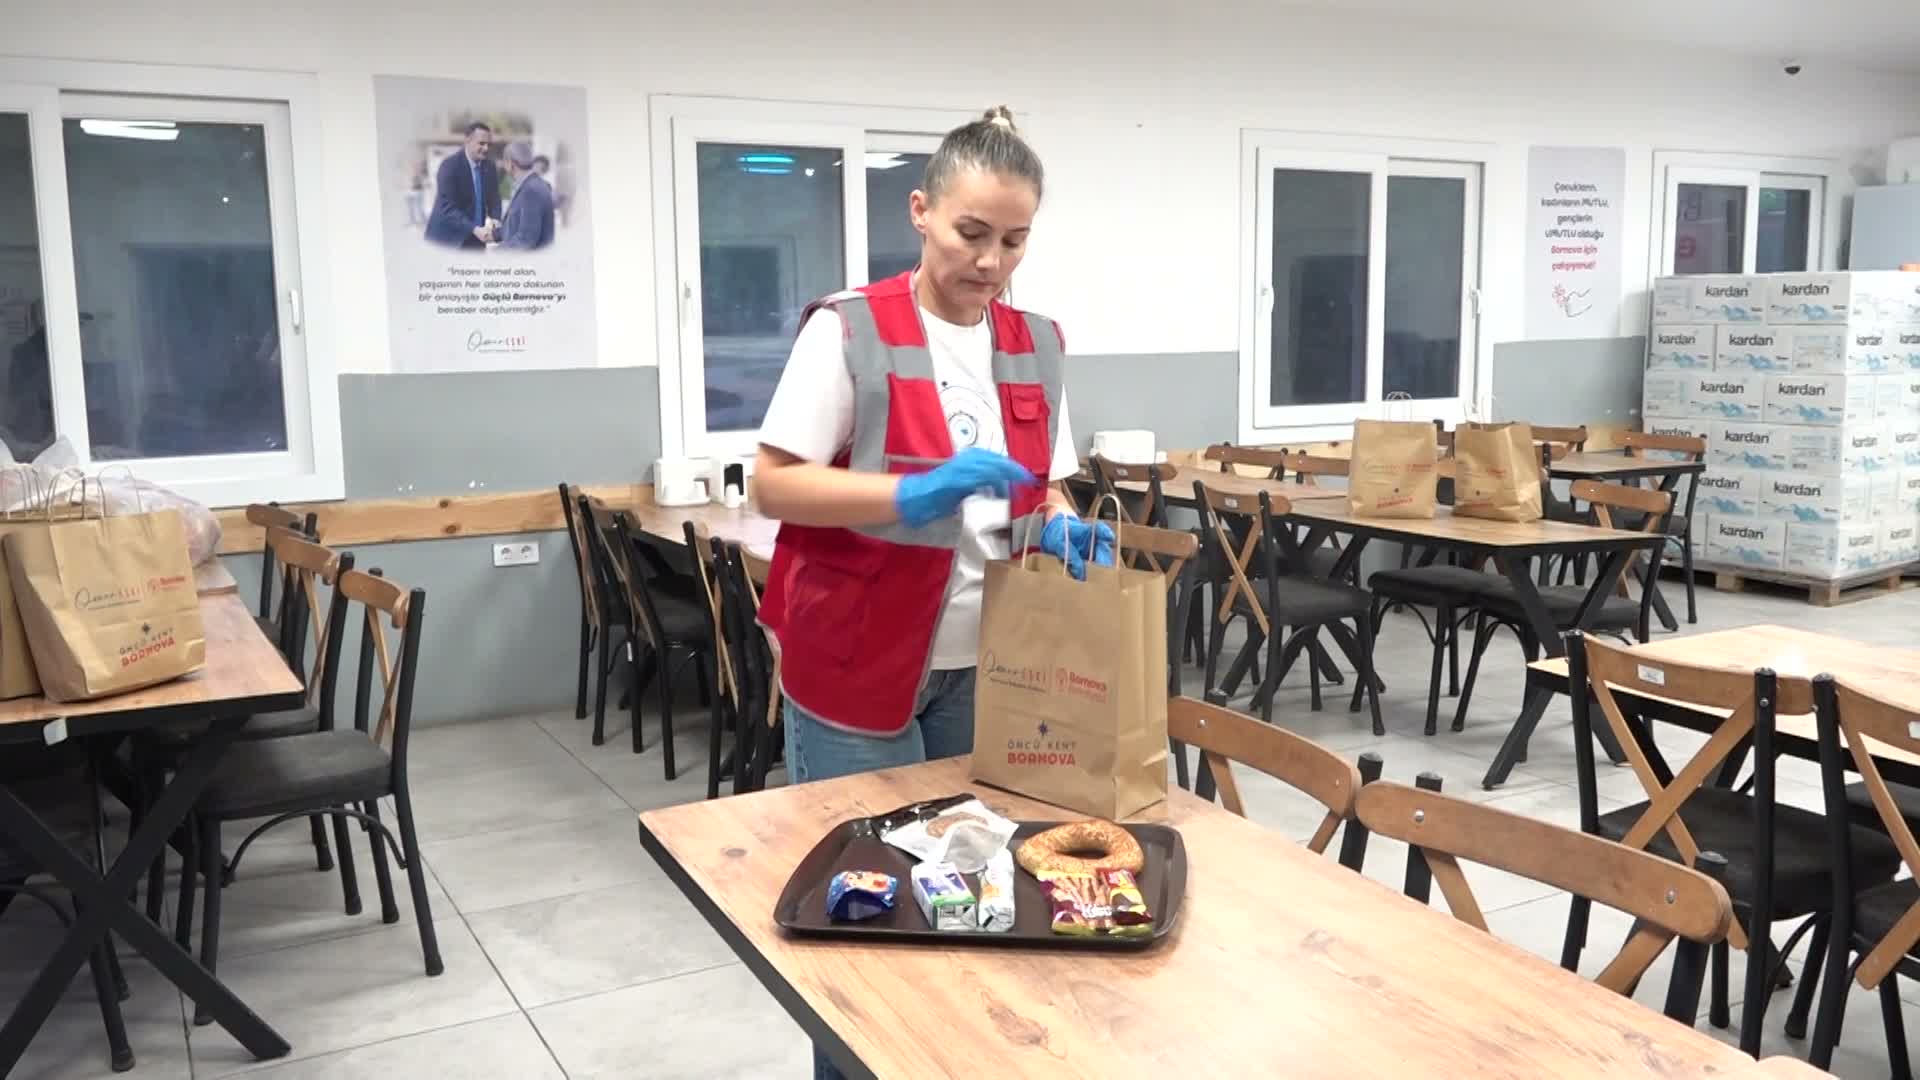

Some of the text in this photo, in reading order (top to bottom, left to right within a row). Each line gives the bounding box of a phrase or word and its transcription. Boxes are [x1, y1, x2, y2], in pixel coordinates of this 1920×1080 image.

[1551, 245, 1583, 254] Bornova
[465, 280, 480, 289] her
[1782, 283, 1830, 297] kardan
[418, 293, 433, 302] bir
[482, 292, 511, 303] Güçlü
[1705, 285, 1749, 298] kardan
[437, 305, 477, 315] beraber
[1658, 333, 1696, 345] kardan
[1729, 334, 1774, 347] kardan
[1700, 381, 1745, 394] kardan
[1778, 383, 1826, 396] kardan
[1725, 430, 1769, 444] kardan
[1774, 482, 1821, 497] kardan
[1719, 524, 1764, 539] kardan
[1068, 671, 1107, 692] Bornova
[1047, 741, 1078, 751] KENT
[1007, 752, 1076, 766] BORNOVA
